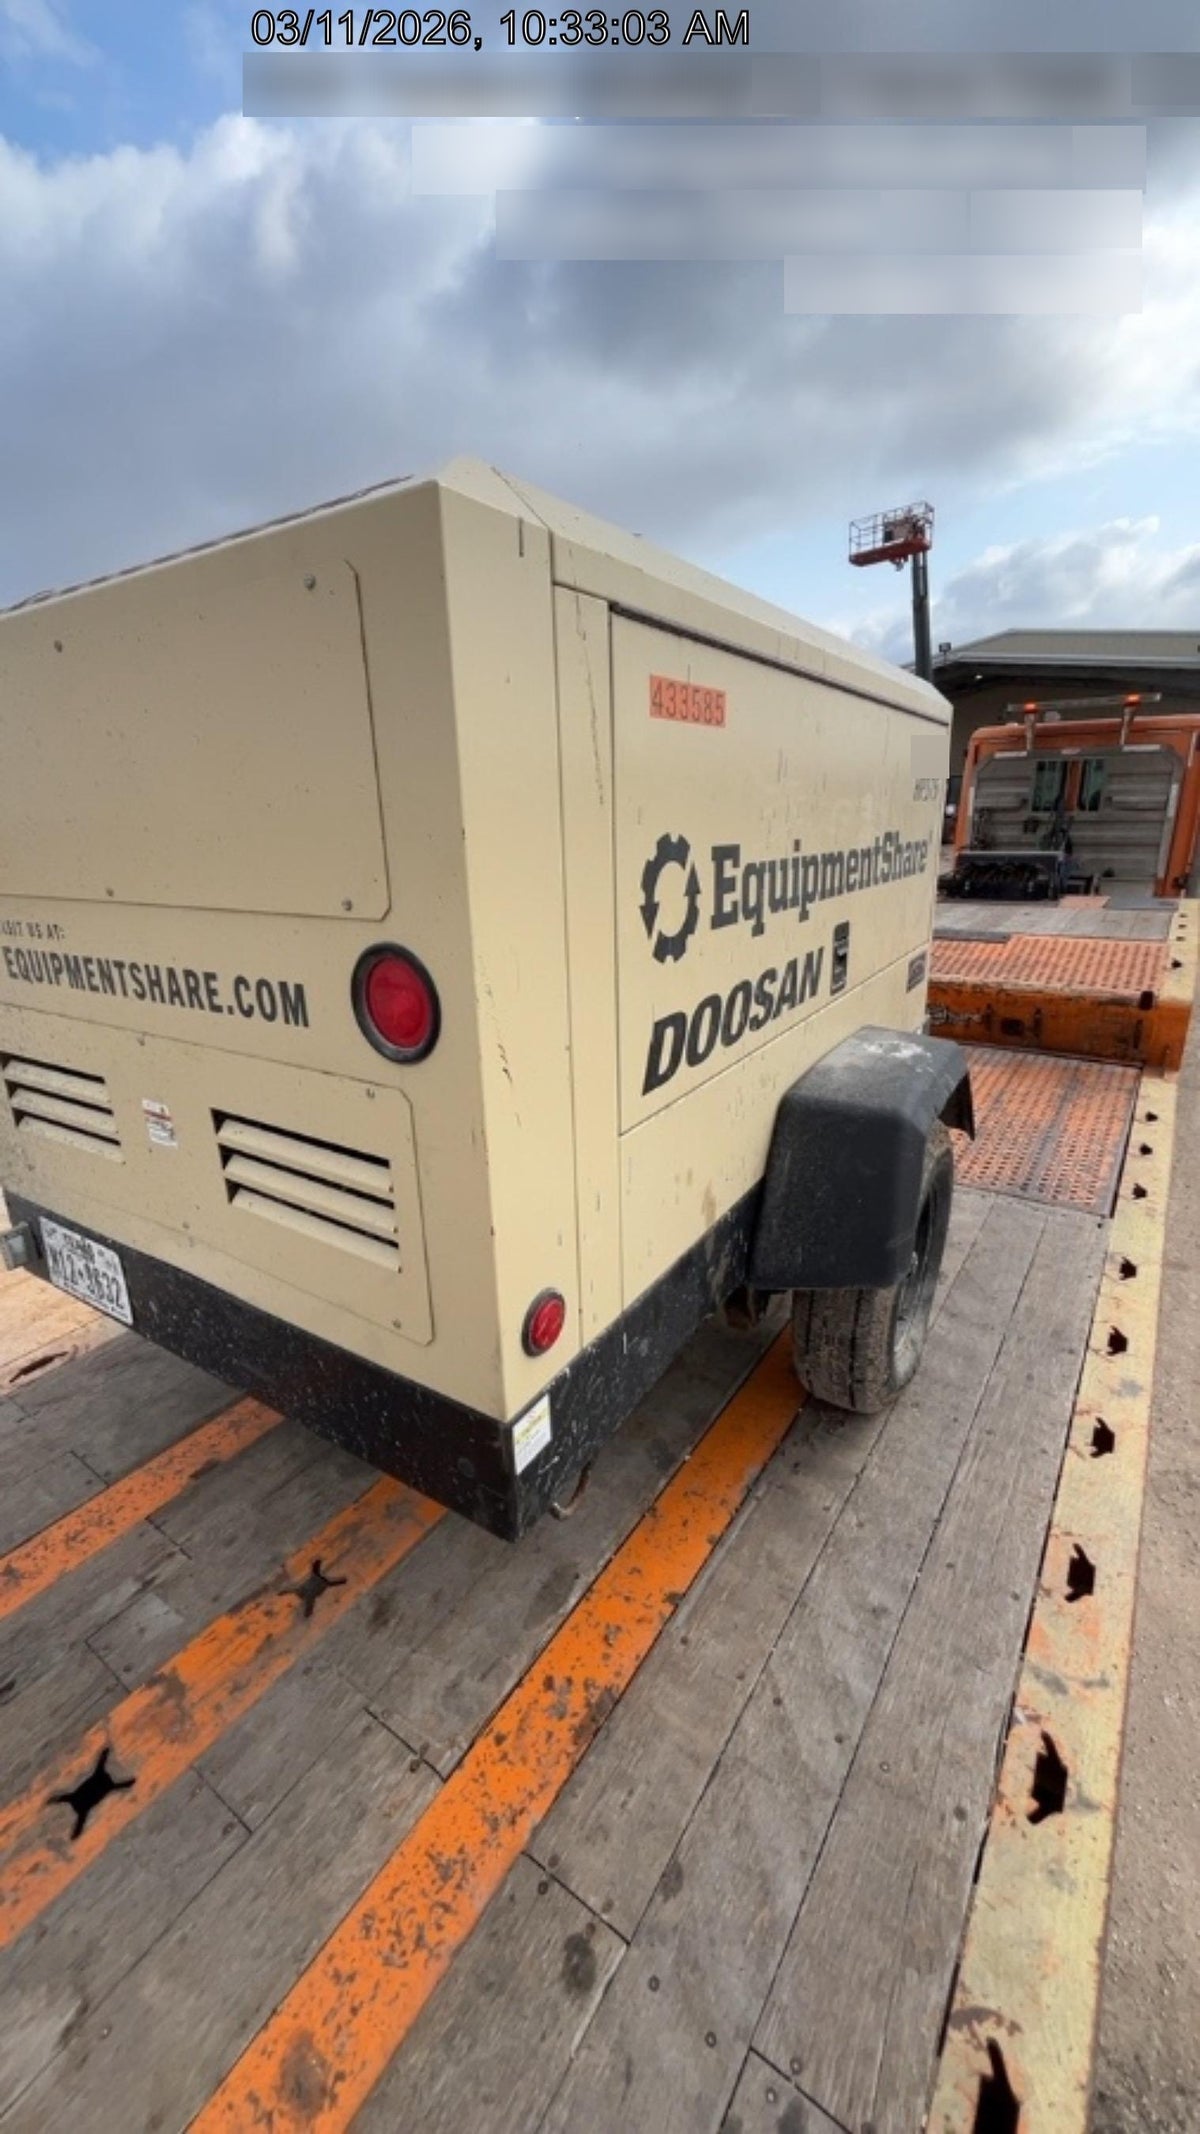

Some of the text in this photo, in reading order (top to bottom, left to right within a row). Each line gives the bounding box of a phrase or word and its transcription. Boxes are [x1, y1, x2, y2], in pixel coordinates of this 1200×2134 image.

[650, 680, 725, 724] 433585
[711, 832, 927, 937] EquipmentShare
[2, 945, 310, 1028] EQUIPMENTSHARE.COM
[642, 946, 824, 1096] DOOSAN
